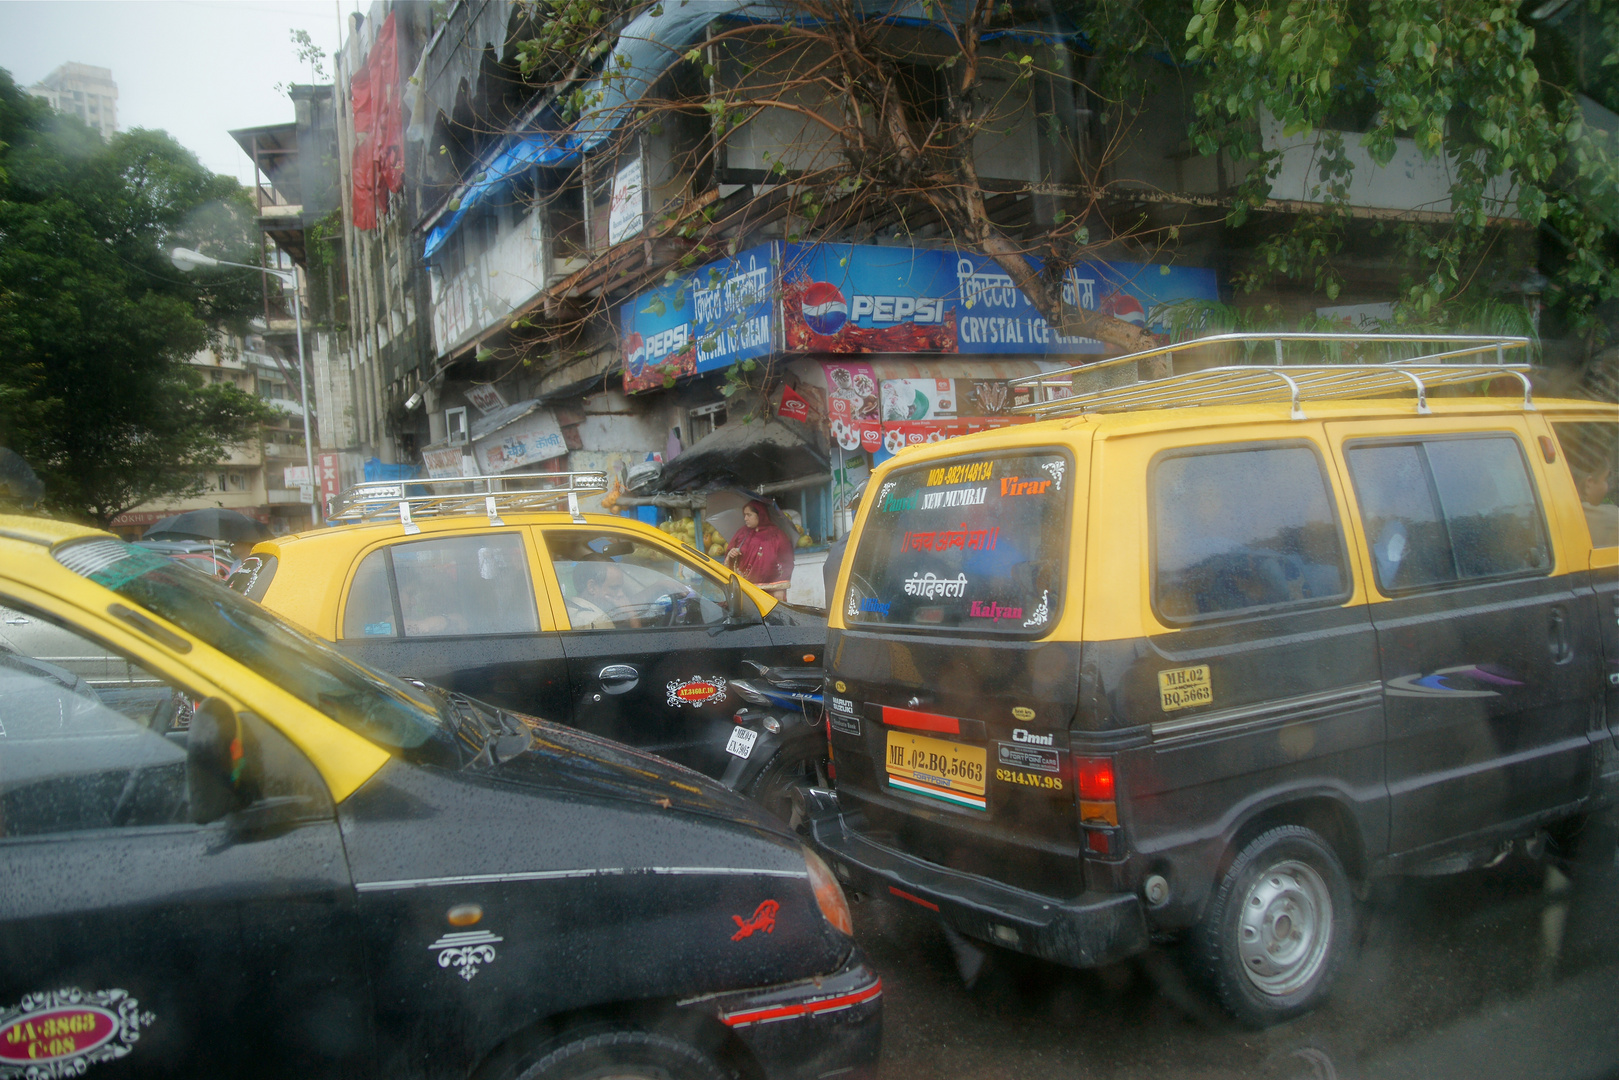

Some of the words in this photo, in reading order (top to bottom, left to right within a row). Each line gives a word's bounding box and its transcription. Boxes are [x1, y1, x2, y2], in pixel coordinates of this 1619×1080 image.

[851, 295, 945, 323] PEPSI
[740, 314, 770, 350] CREAM
[960, 316, 1024, 344] CRYSTAL
[1027, 318, 1050, 344] ICE
[645, 322, 689, 361] PEPSI
[926, 468, 946, 487] MOB
[1000, 476, 1051, 497] Virar
[882, 489, 919, 513] Panvel
[920, 493, 944, 510] NEW
[943, 487, 988, 508] MUMBAI
[970, 600, 1023, 623] Kalyan
[1165, 668, 1204, 686] MH.02
[1163, 687, 1210, 706] BQ.5663
[832, 703, 854, 714] SUZUKI
[1012, 728, 1054, 746] Omni
[996, 768, 1063, 790] 8214.W.98
